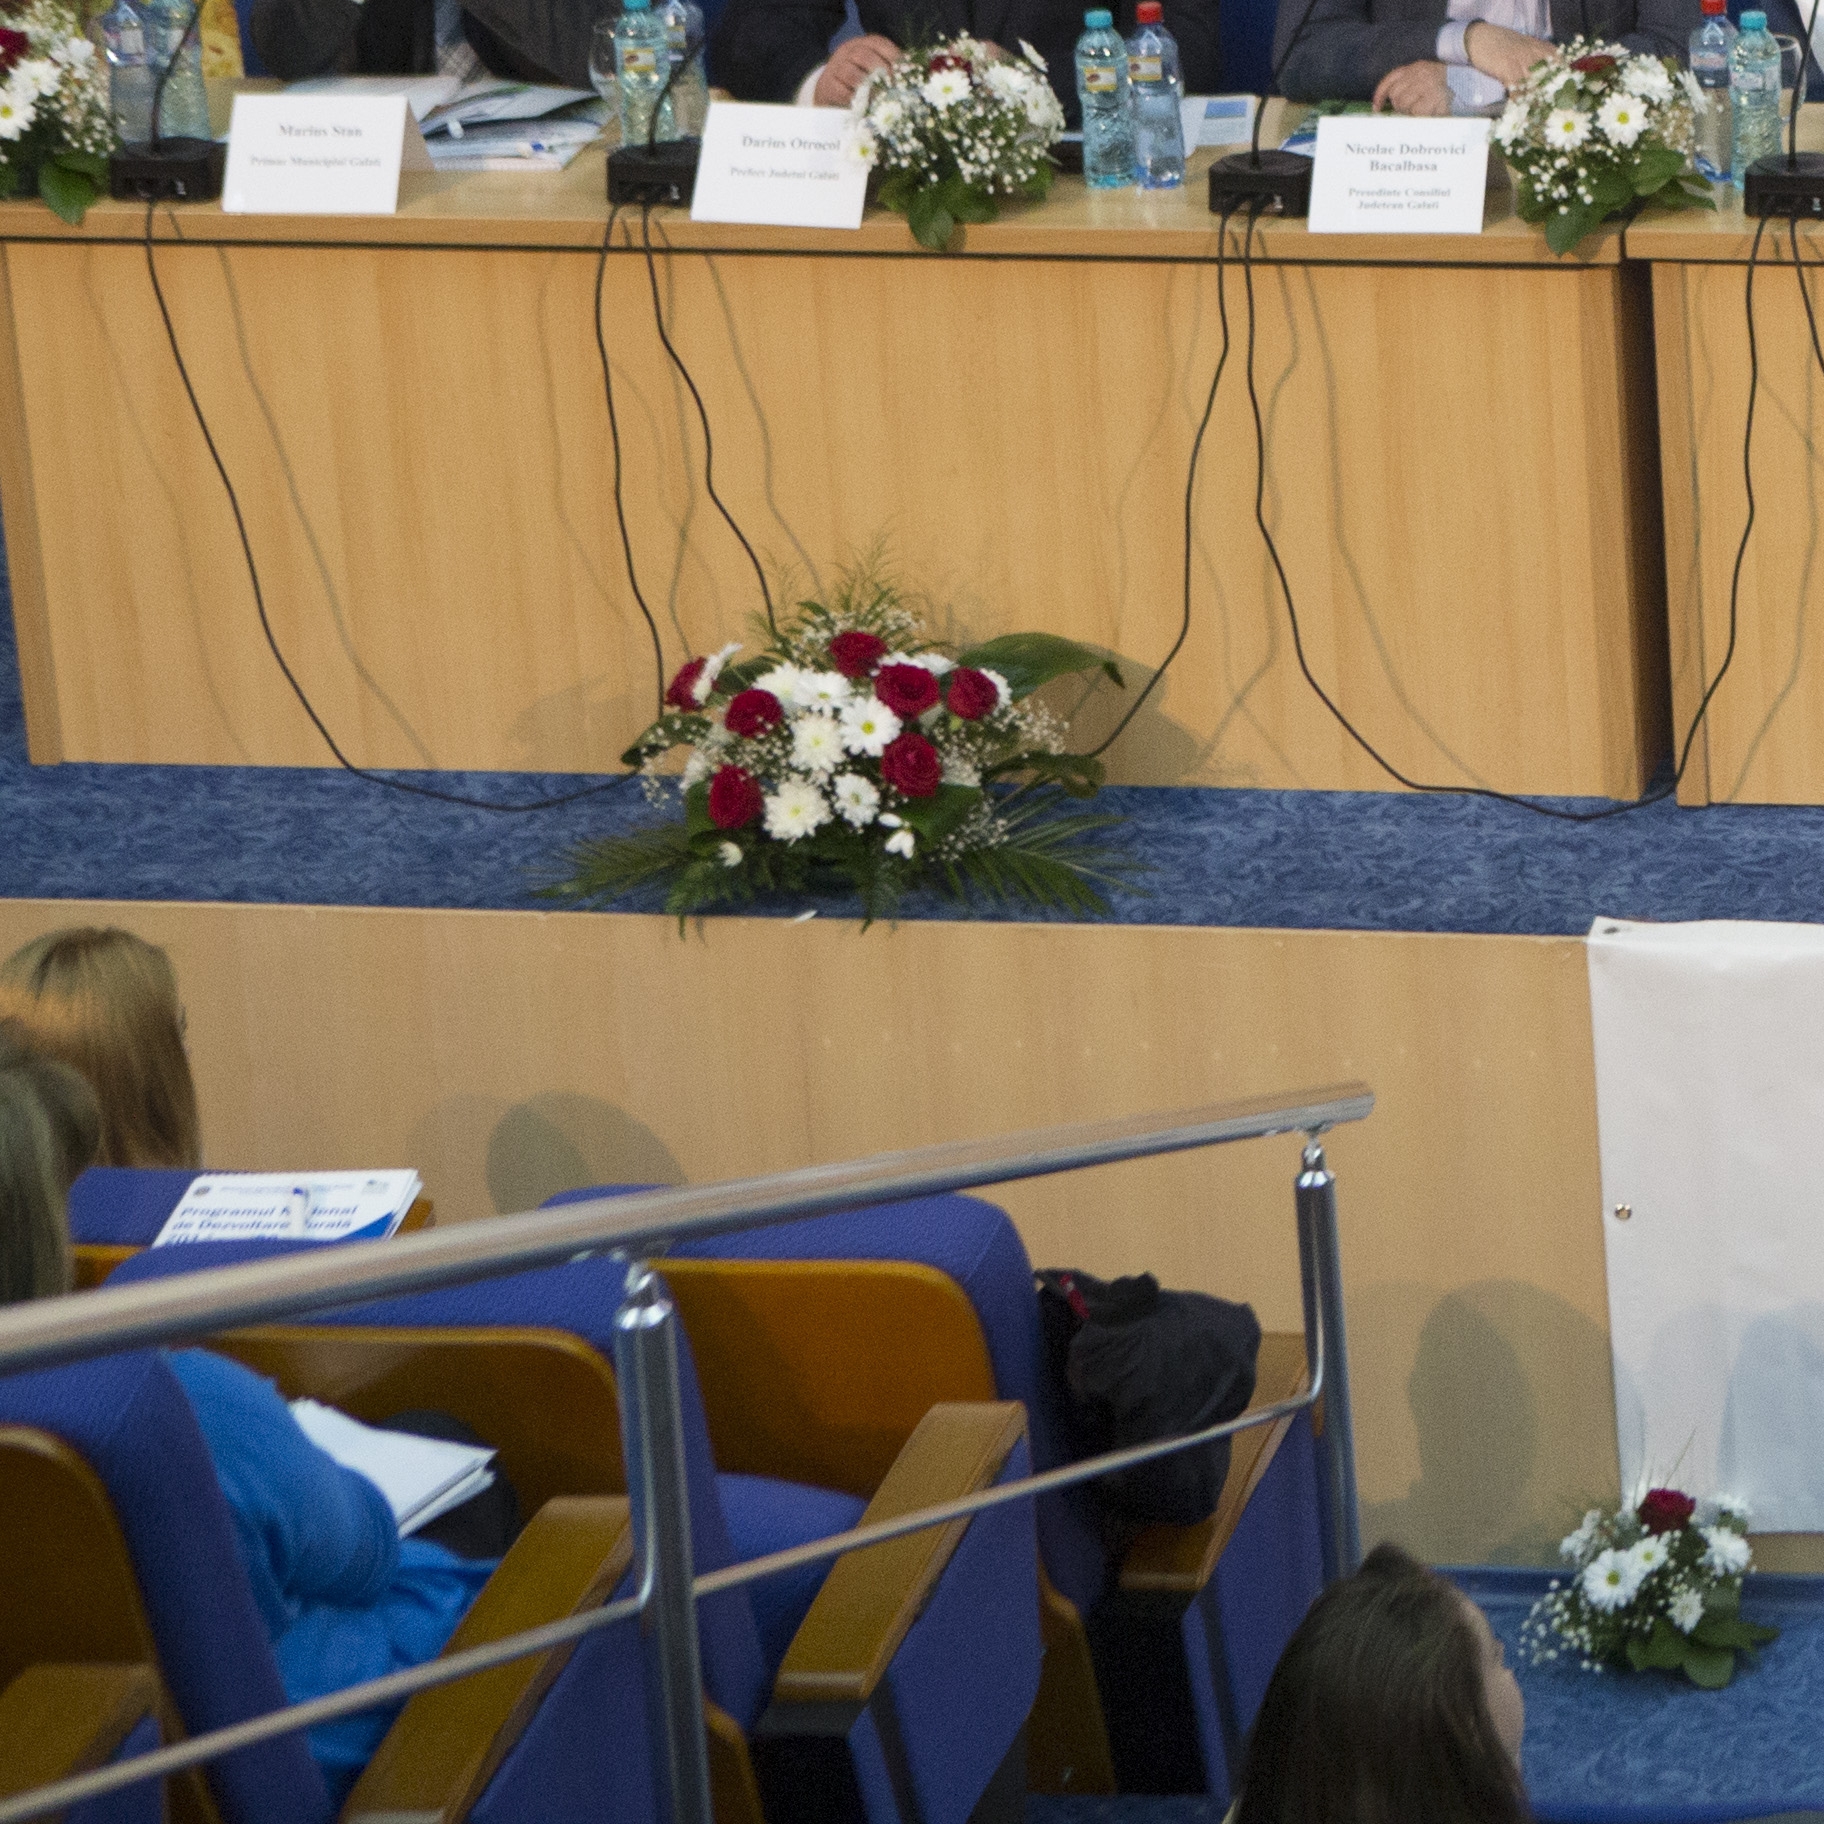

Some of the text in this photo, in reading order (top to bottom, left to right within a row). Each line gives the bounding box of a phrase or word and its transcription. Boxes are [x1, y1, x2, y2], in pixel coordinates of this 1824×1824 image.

[279, 125, 363, 137] Marius Stan
[742, 135, 786, 149] Darius
[1345, 142, 1466, 156] Nicolae Dobrovici
[180, 1205, 277, 1218] Programul
